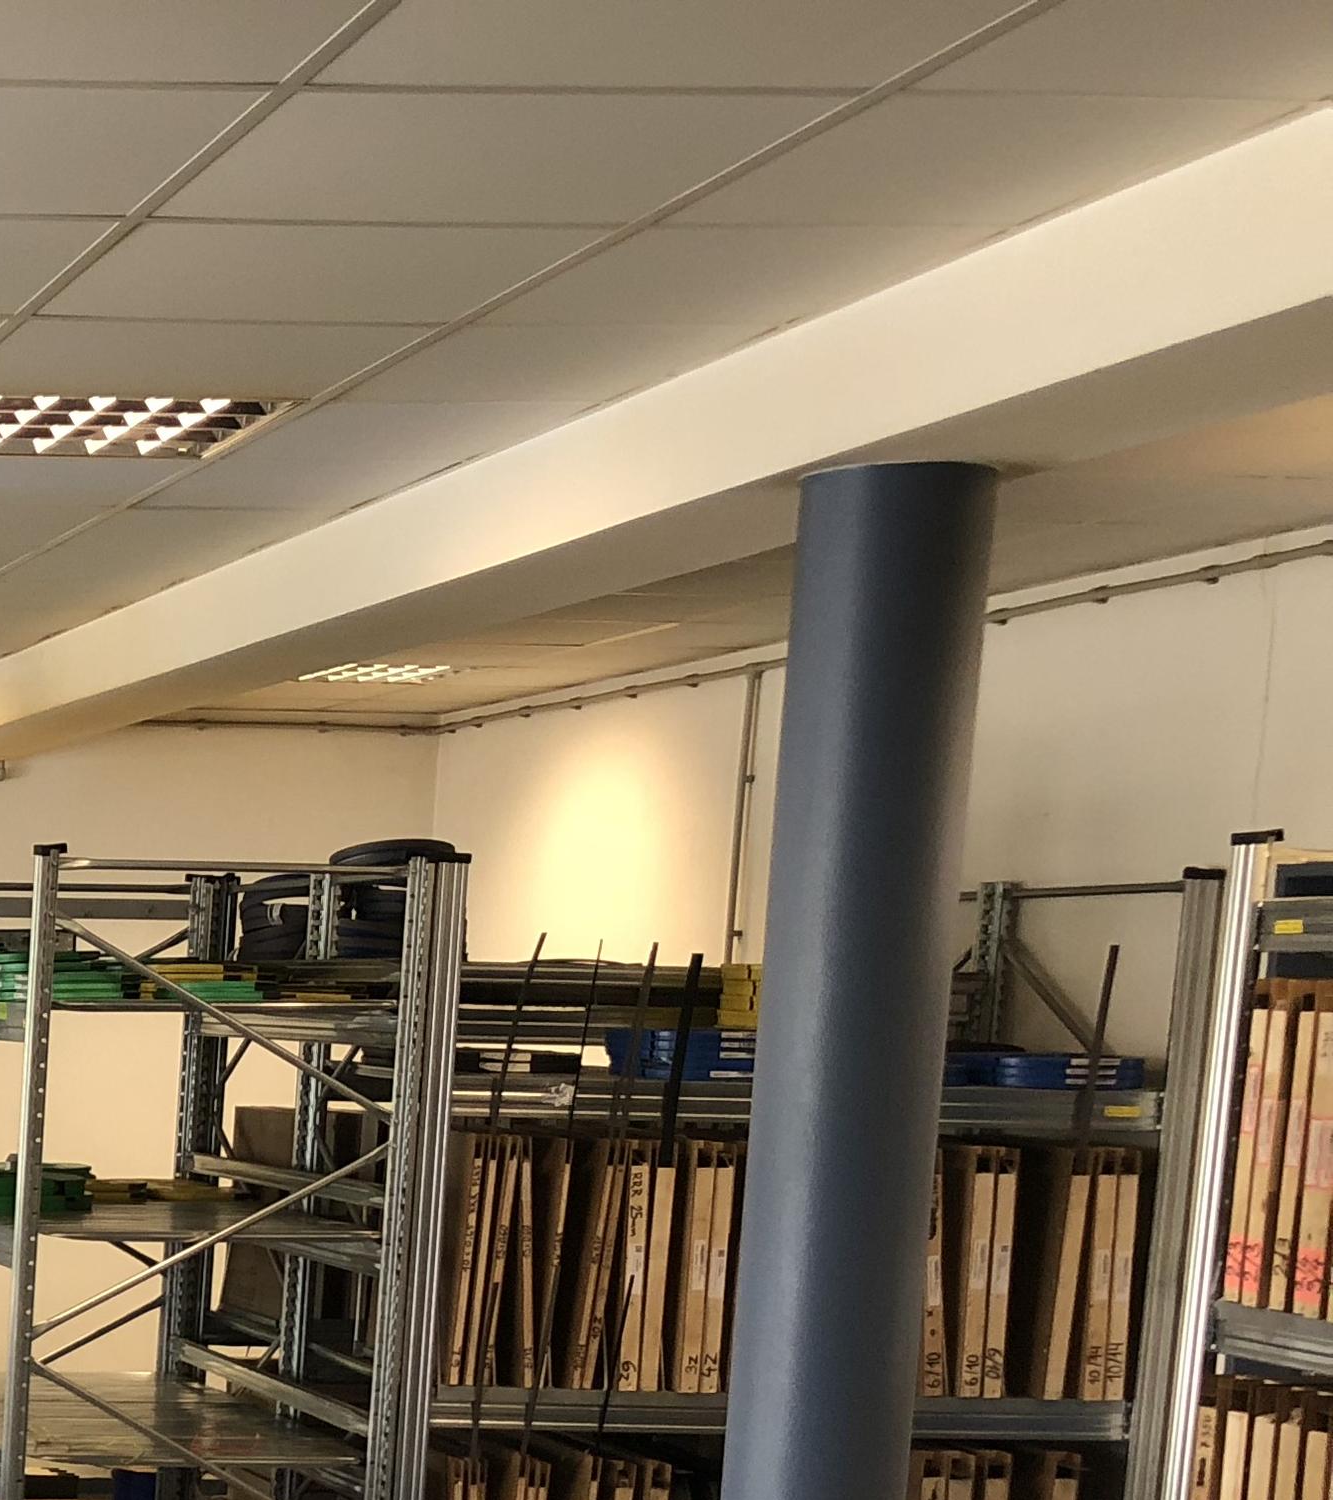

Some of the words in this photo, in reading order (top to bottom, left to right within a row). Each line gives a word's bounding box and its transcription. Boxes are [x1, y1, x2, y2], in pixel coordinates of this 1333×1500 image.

[926, 1351, 940, 1390] 6/10
[965, 1354, 979, 1387] 6/10
[1088, 1345, 1102, 1386] 10/14
[1107, 1342, 1124, 1383] 10/14
